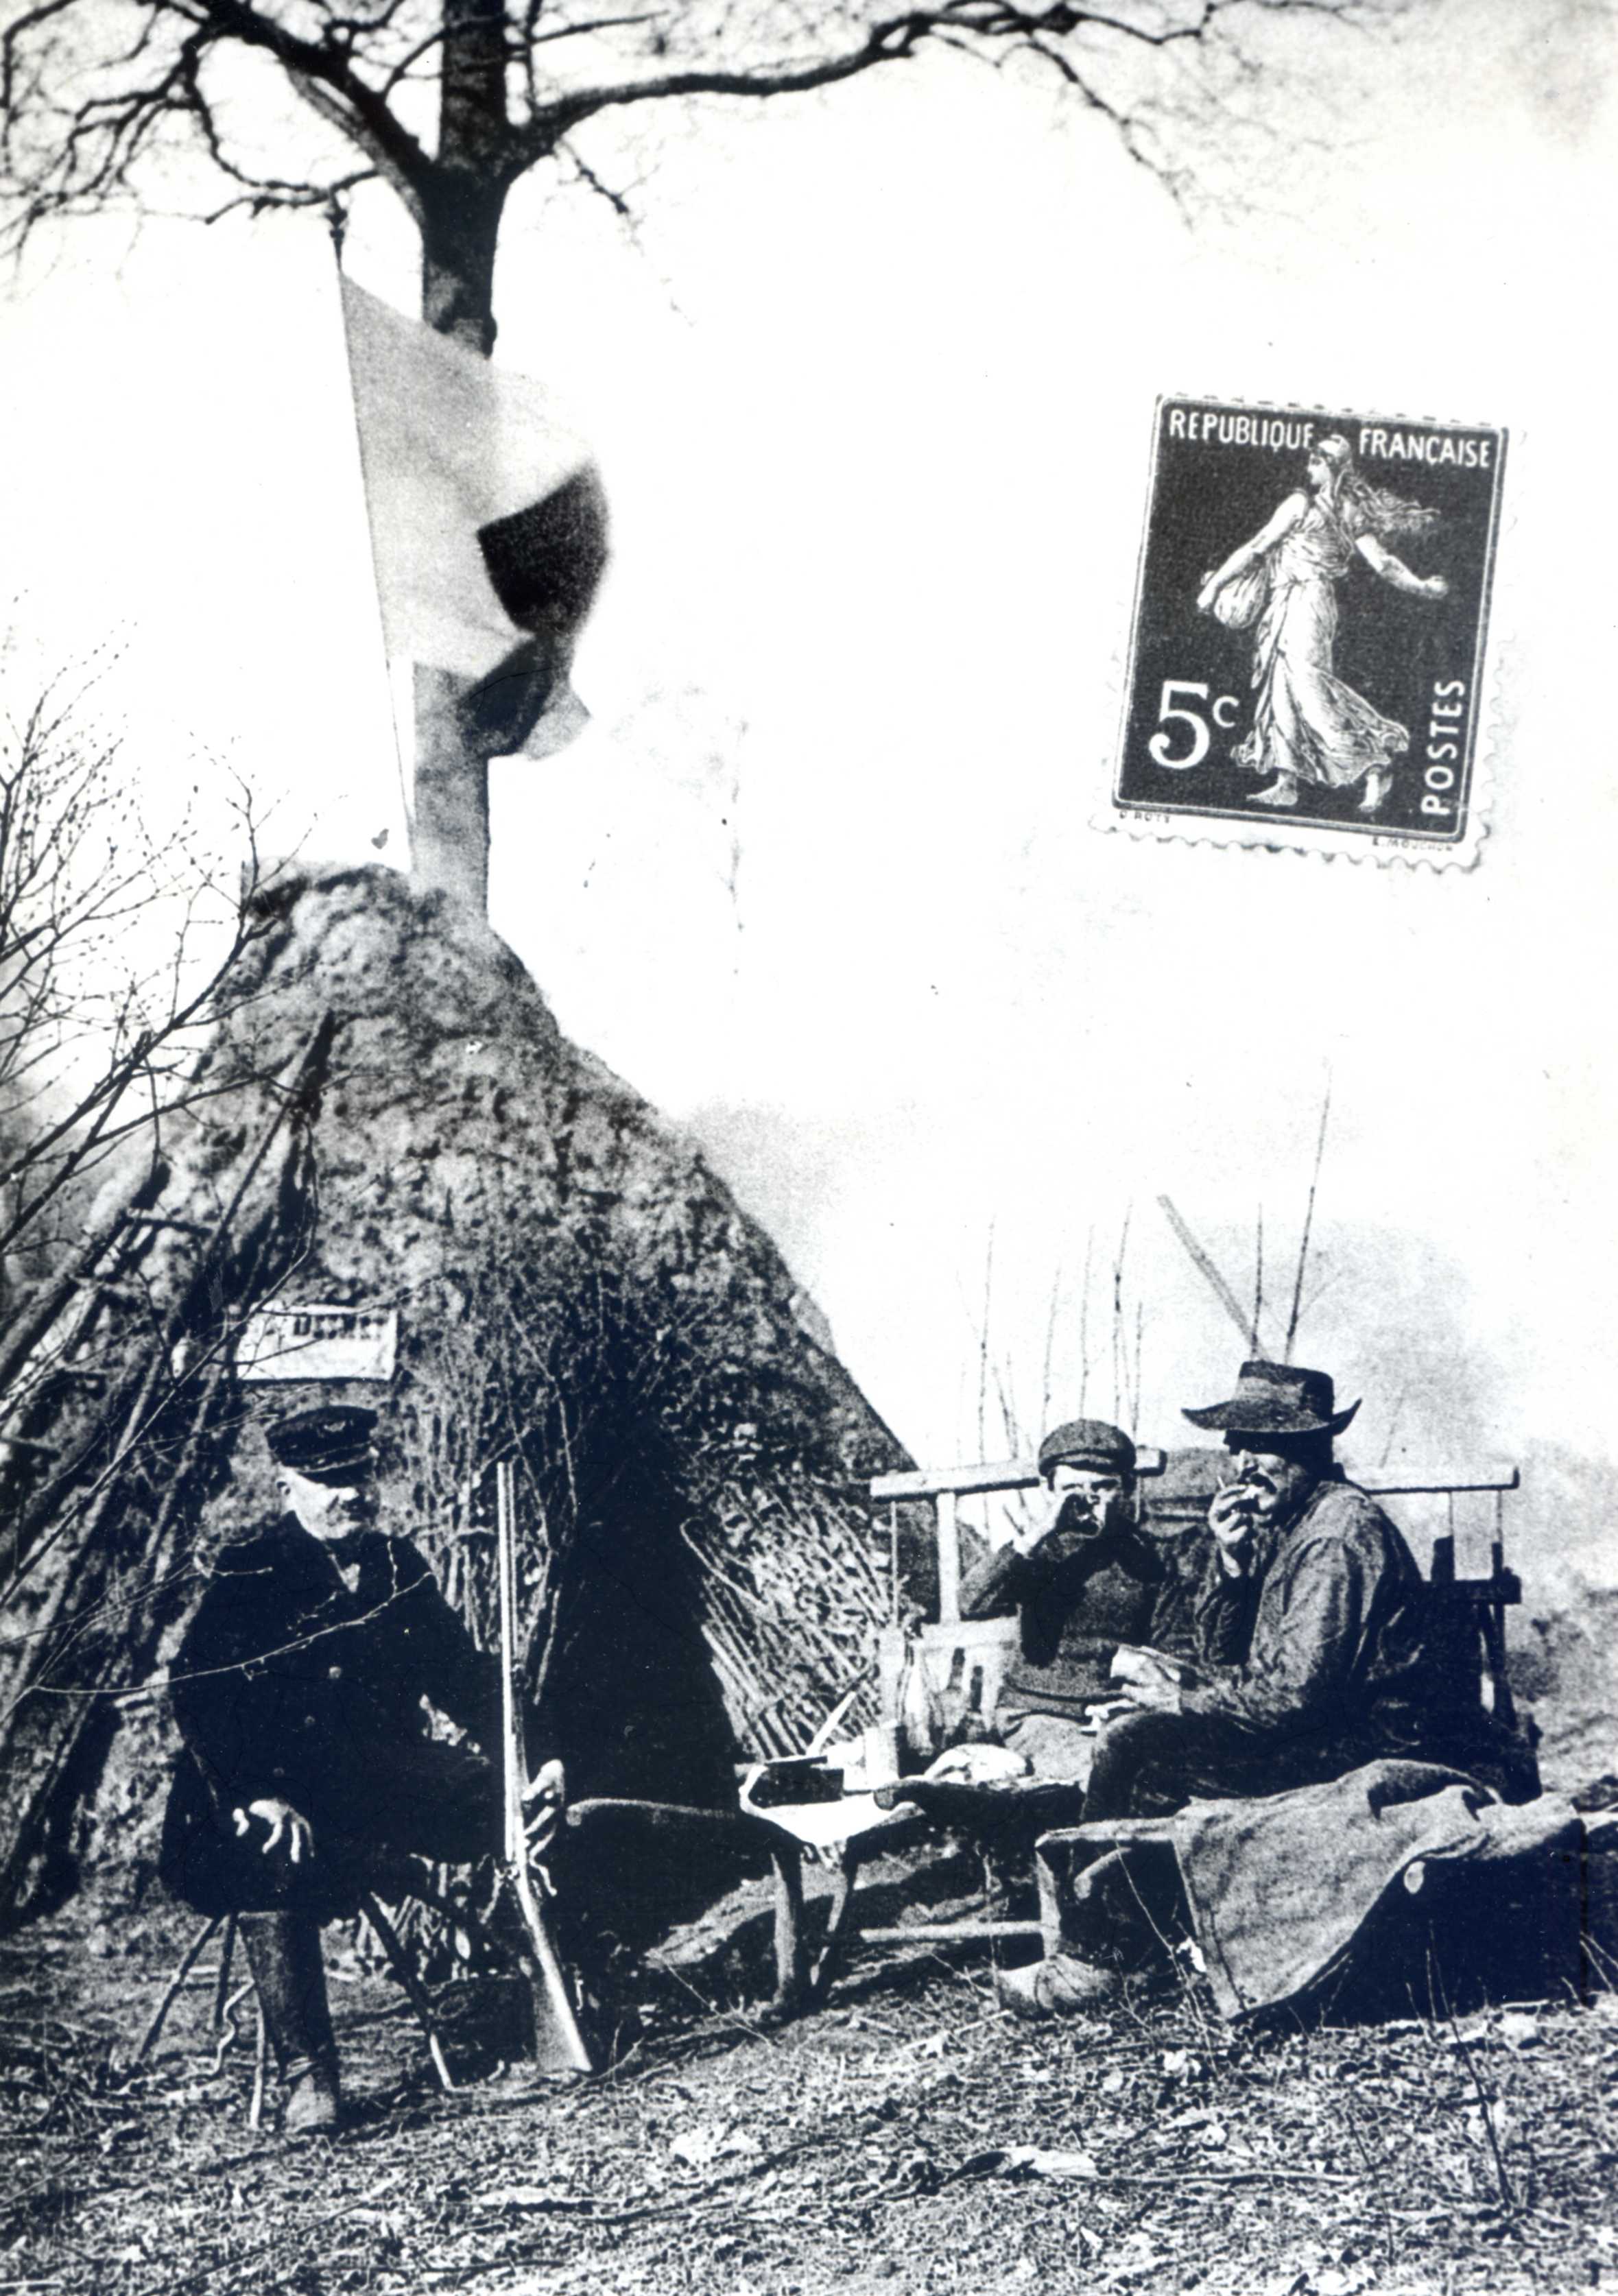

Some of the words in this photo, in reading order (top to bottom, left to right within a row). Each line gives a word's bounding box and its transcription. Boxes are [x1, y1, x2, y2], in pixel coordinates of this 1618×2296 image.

[1169, 409, 1314, 452] REPUBLIQUE
[1359, 428, 1490, 468] FRANÇAISE
[1420, 680, 1465, 816] POSTES
